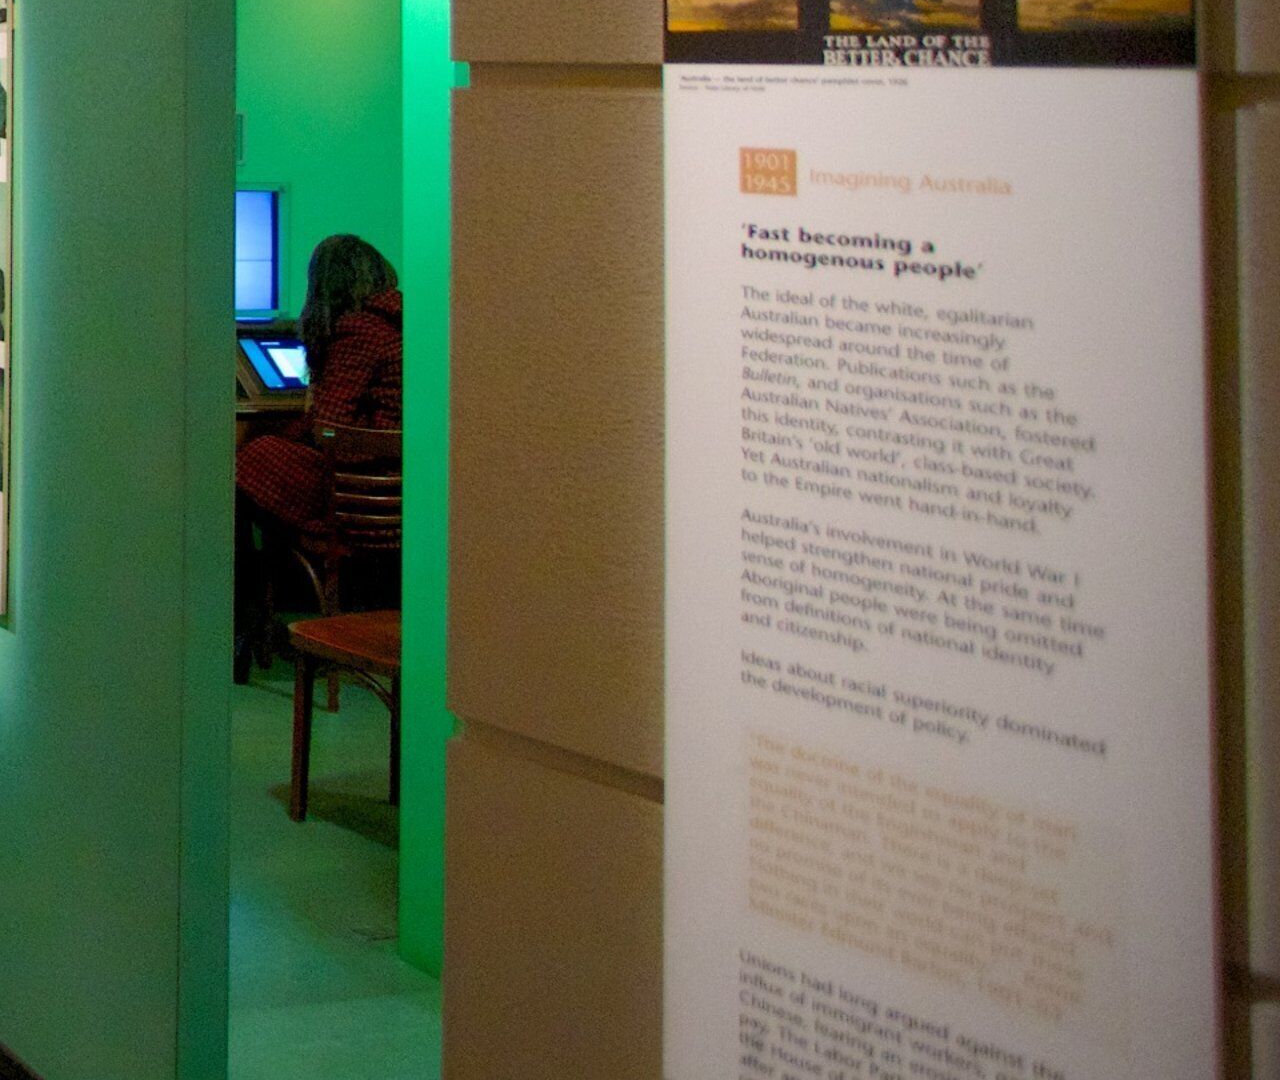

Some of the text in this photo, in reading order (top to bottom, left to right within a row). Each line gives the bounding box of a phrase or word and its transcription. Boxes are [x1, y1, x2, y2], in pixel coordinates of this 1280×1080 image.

[823, 35, 990, 49] THE LAND OF THE
[904, 49, 990, 67] CHANCE
[744, 153, 789, 170] 1901
[744, 174, 791, 192] 1945
[810, 169, 1014, 196] Imagining Australia
[740, 242, 886, 270] homogenous
[798, 226, 913, 257] becoming
[920, 240, 936, 255] a
[740, 305, 1007, 352] Australian became increasingly
[741, 285, 770, 301] The
[776, 289, 814, 307] ideal
[819, 293, 836, 308] of
[841, 295, 870, 312] the
[936, 308, 1035, 331] egalitarian
[740, 327, 1010, 371] widespread around the time of
[741, 345, 1056, 402] Federation. Publications such as the
[741, 366, 1078, 427] Bulletin, and organisations such as the
[740, 387, 820, 410] Australian
[899, 409, 1007, 441] Association,
[1014, 425, 1097, 453] fostered
[741, 407, 1075, 473] this identity, contrasting it with Great
[741, 446, 1073, 521] Yet Australian nationalism and loyalty
[741, 469, 758, 482] to
[763, 471, 789, 488] the
[795, 477, 853, 499] Empire
[859, 491, 903, 510] went
[914, 456, 1017, 485] class-based
[1024, 475, 1095, 502] society.
[741, 528, 1076, 610] helped strengthen national pride and
[826, 524, 933, 558] involvement
[940, 547, 957, 563] in
[963, 549, 1021, 576] World
[1027, 563, 1065, 584] War
[741, 551, 784, 569] sense
[789, 559, 806, 573] of
[938, 589, 957, 607] At
[964, 595, 994, 615] the
[1002, 605, 1053, 628] same
[1060, 616, 1106, 640] time
[741, 568, 1084, 658] Aboriginal people were being omitted
[741, 612, 771, 628] and
[741, 588, 1056, 677] from definitions of national identity
[740, 670, 767, 689] the
[771, 678, 883, 720] development
[889, 709, 908, 726] of
[740, 649, 1108, 758] Ideas about racial superiority dominated
